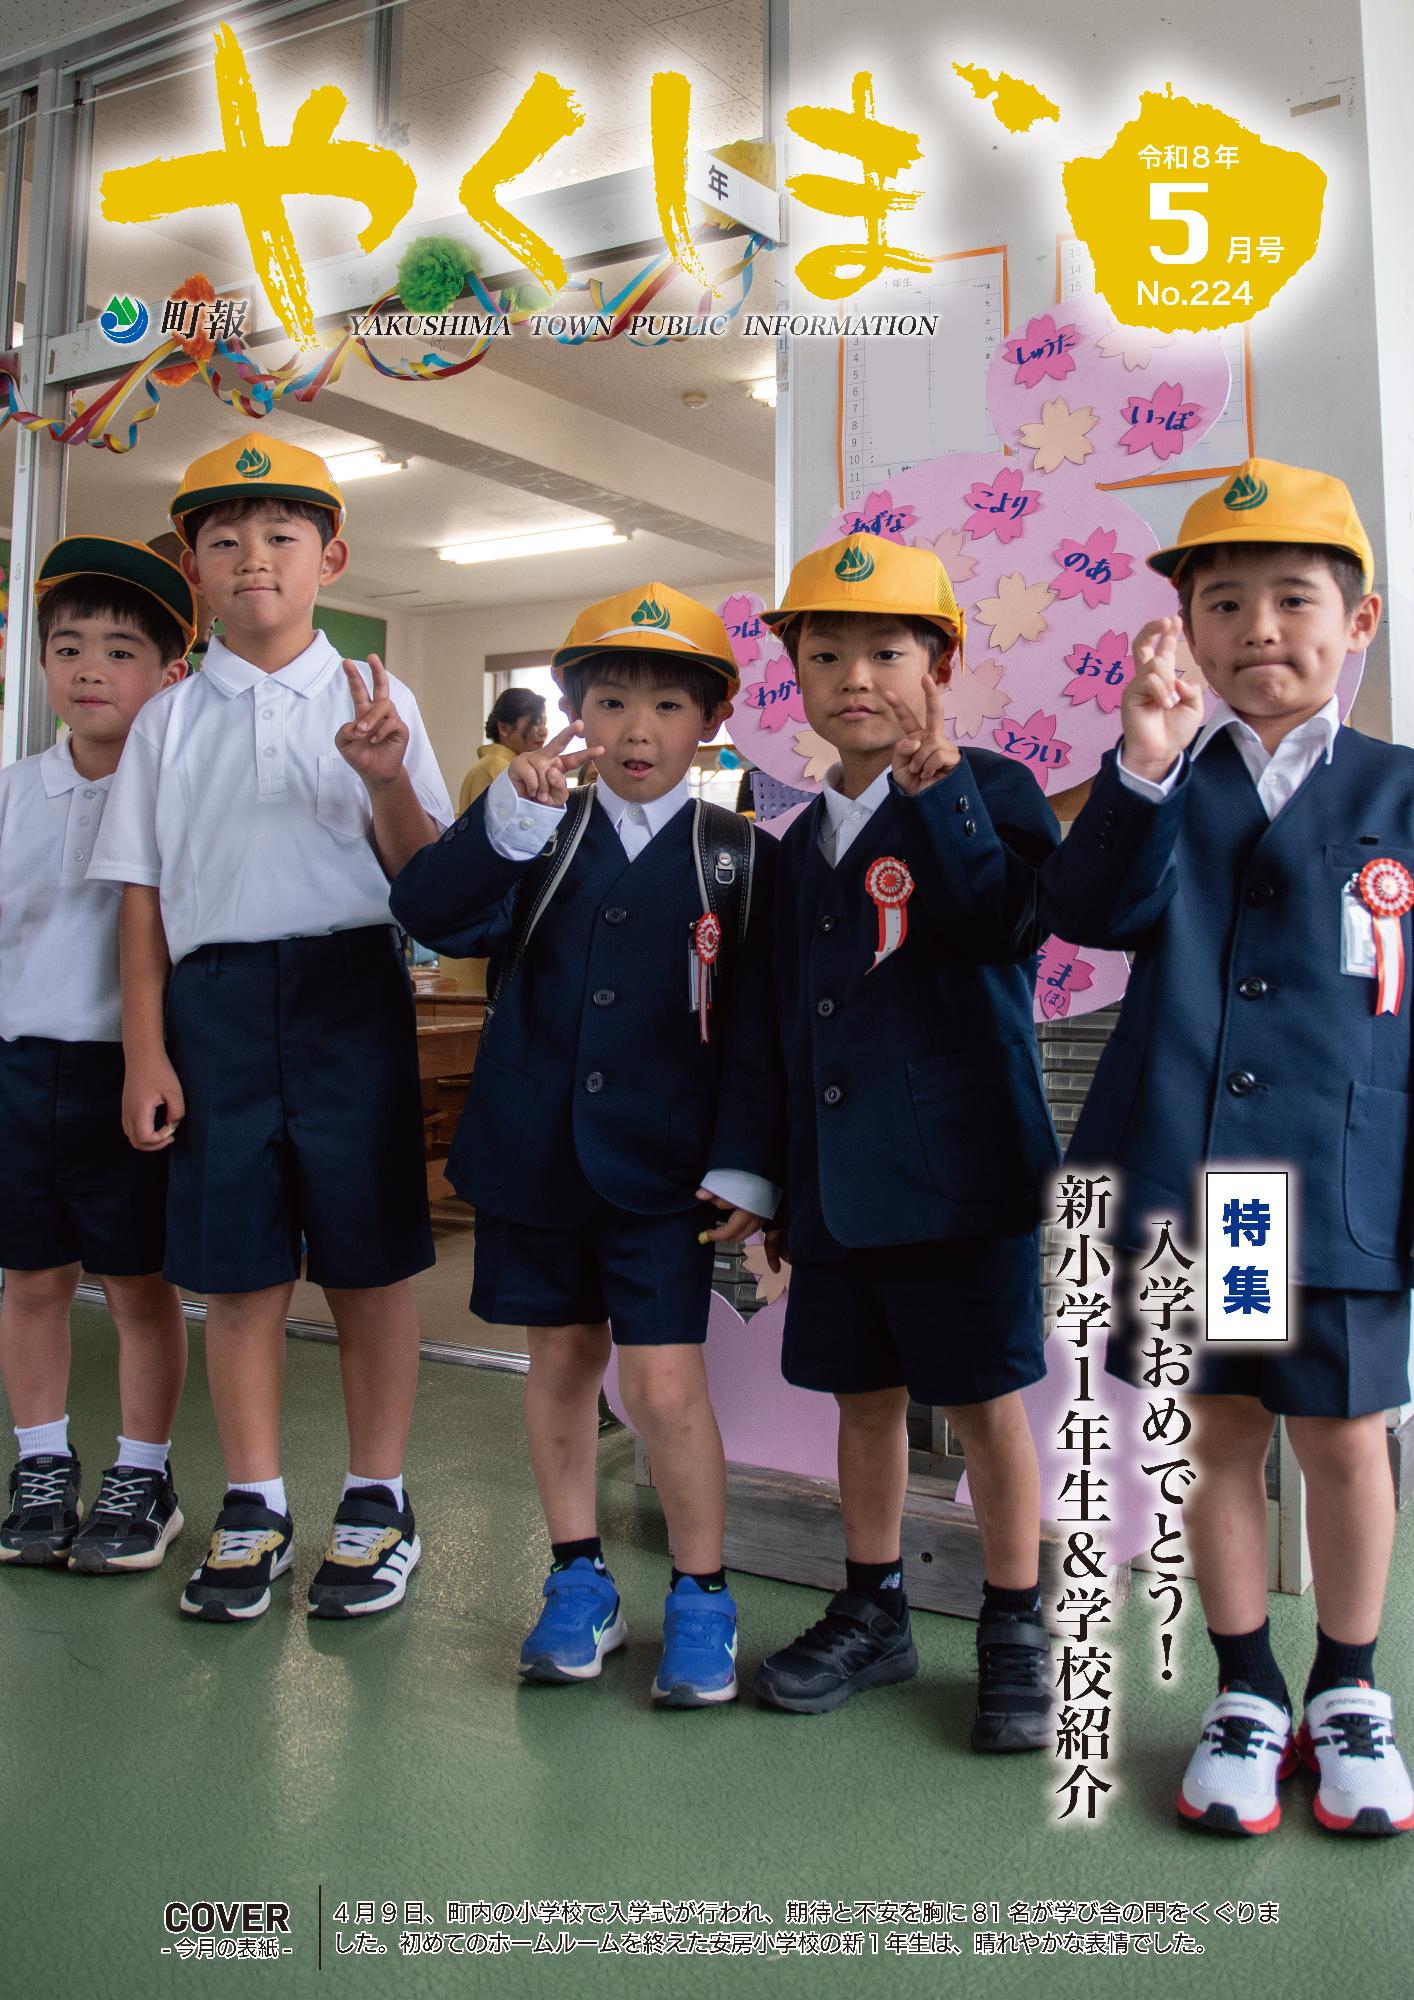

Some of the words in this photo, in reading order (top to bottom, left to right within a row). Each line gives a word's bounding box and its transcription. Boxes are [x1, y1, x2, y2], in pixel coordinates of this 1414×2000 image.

[852, 404, 858, 413] 7
[1131, 405, 1194, 431] いっぽ
[851, 420, 858, 430] 8
[851, 438, 857, 448] 9
[850, 455, 860, 465] 10
[850, 472, 860, 482] 11
[850, 490, 861, 501] 12
[974, 490, 1028, 520] こより
[1063, 552, 1112, 585] のあ
[754, 679, 801, 707] わか
